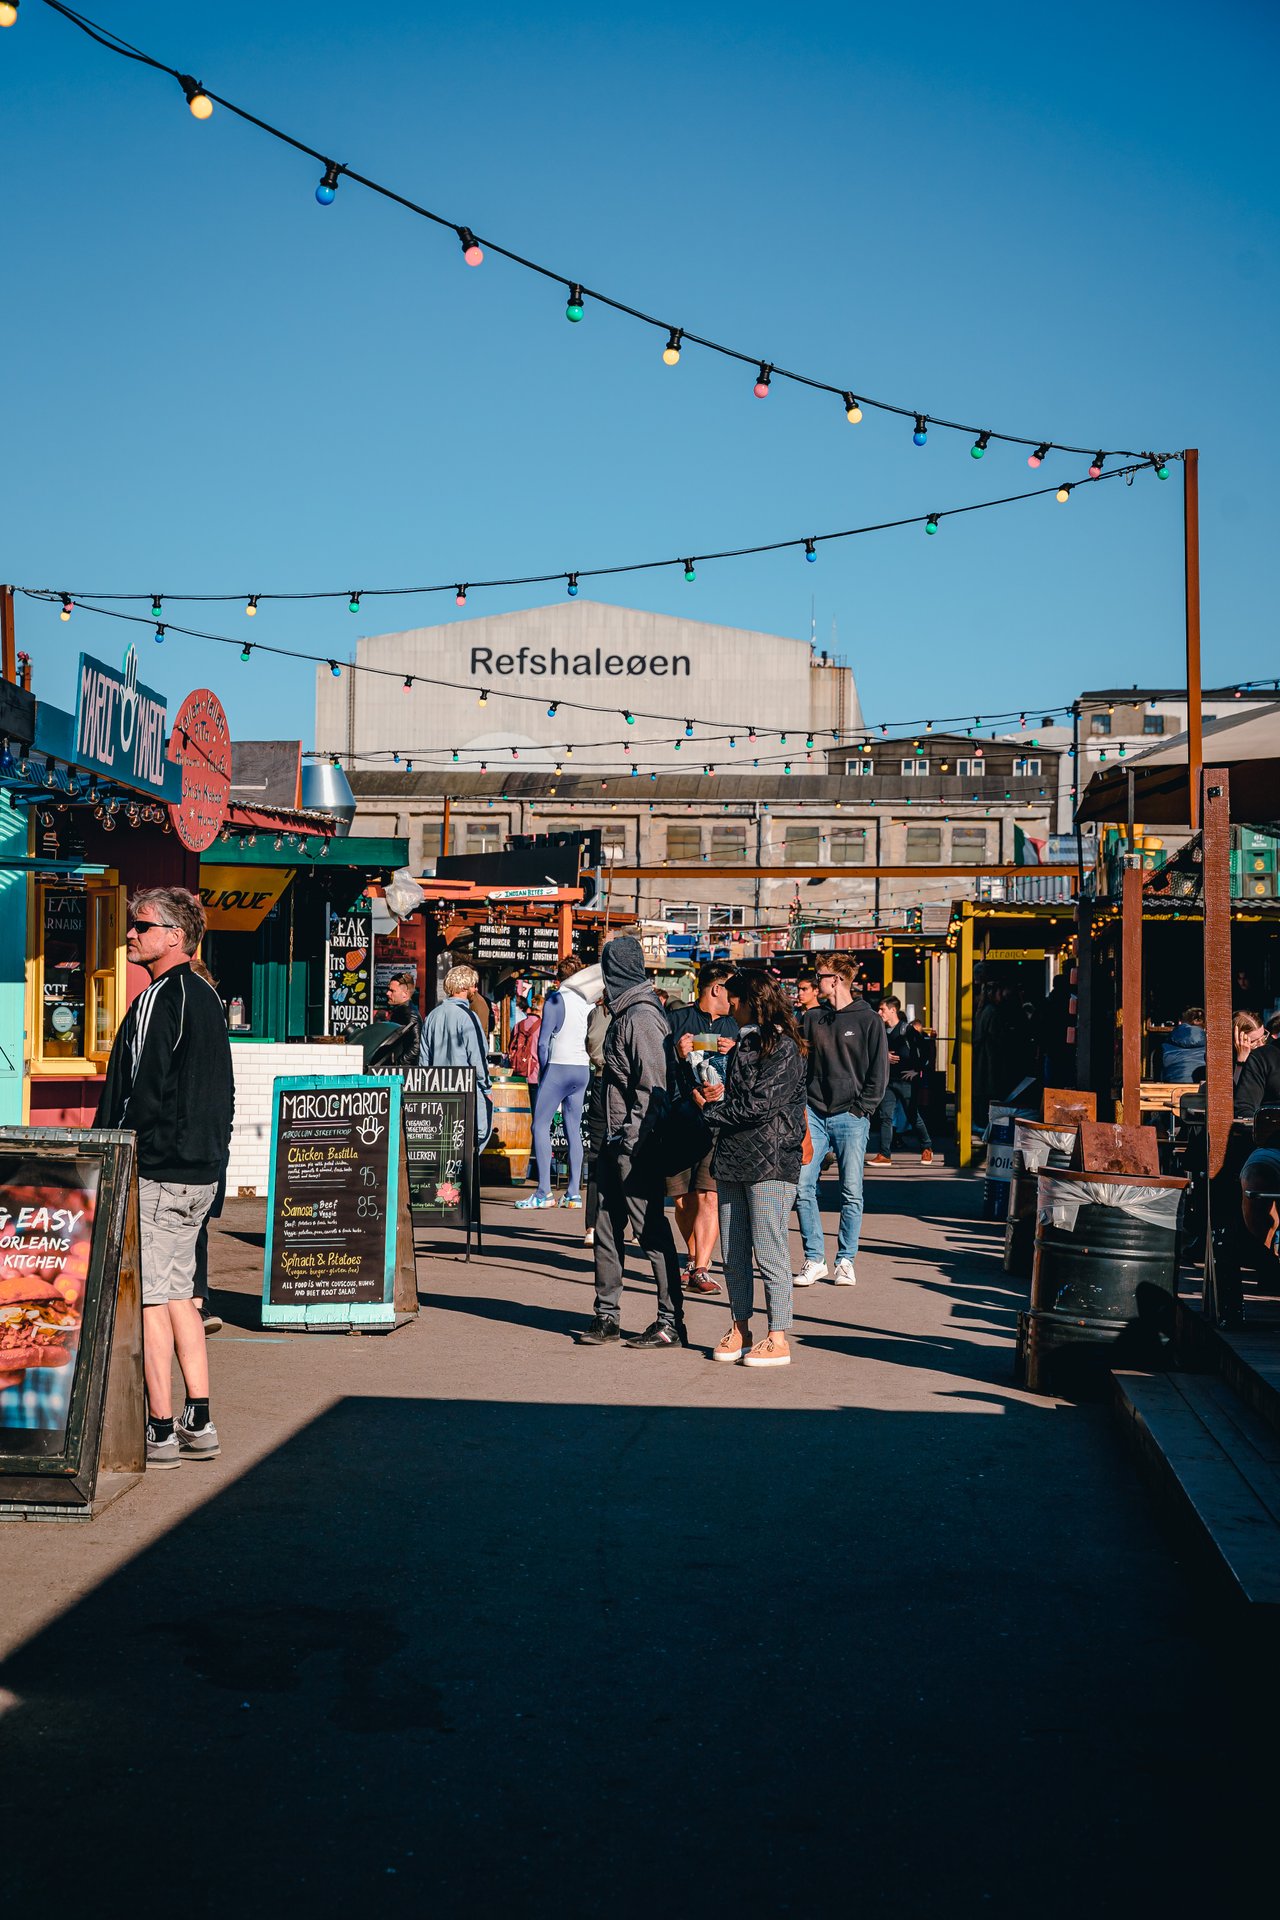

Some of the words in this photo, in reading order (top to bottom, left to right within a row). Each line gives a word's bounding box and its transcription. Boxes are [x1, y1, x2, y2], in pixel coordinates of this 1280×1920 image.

[471, 647, 691, 676] Refshaleøen
[77, 665, 119, 767] MAROC
[133, 694, 167, 786] MAROC
[331, 1005, 369, 1021] MOULES
[422, 1068, 474, 1093] YALLAH
[402, 1103, 418, 1113] AGT
[287, 1146, 324, 1163] Chicken
[326, 1146, 359, 1160] Bastilla
[281, 1197, 313, 1217] Samosa
[319, 1199, 339, 1209] Beef
[318, 1210, 337, 1219] Veggie
[16, 1206, 85, 1233] EASY
[0, 1235, 71, 1252] ORLEANS
[3, 1254, 67, 1270] KITCHEN
[281, 1252, 315, 1273] Spinach
[316, 1253, 326, 1265] &
[327, 1252, 362, 1266] Potatoes
[282, 1281, 293, 1289] ALL
[294, 1281, 308, 1289] FOOD
[321, 1288, 337, 1296] ROOT
